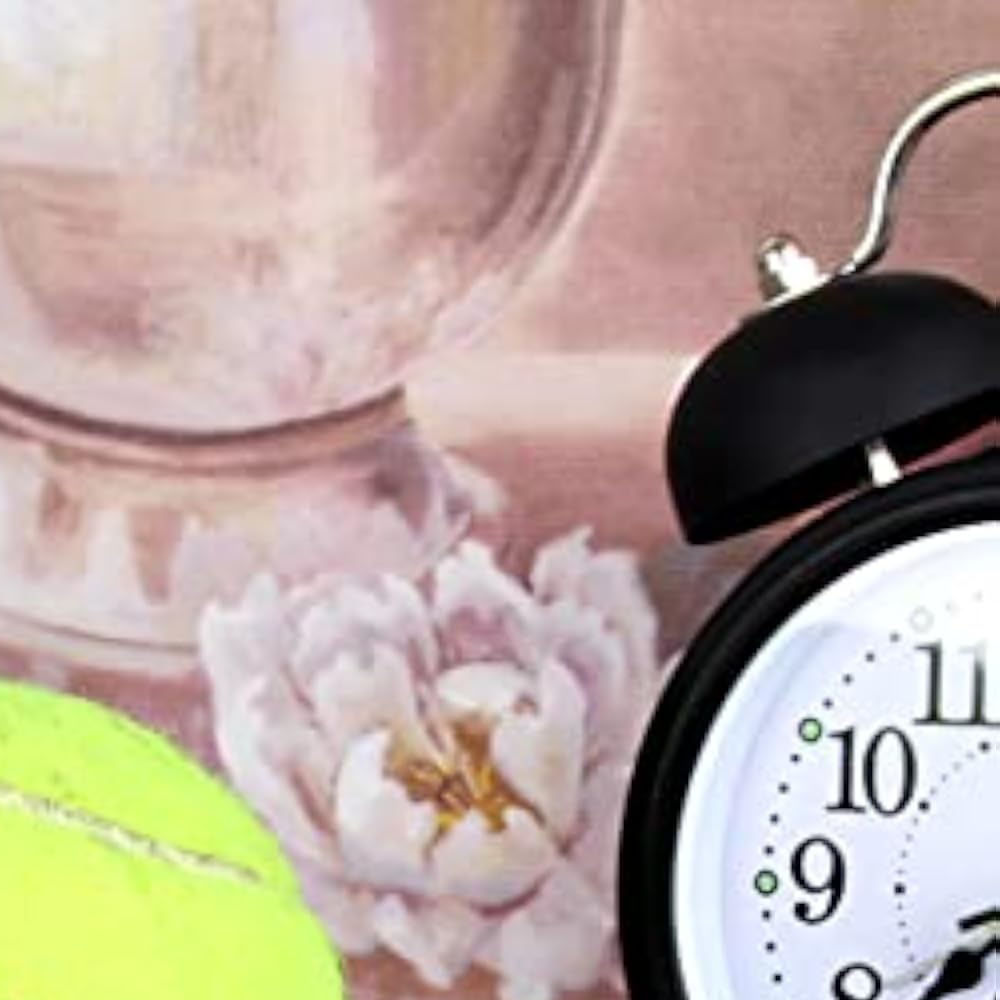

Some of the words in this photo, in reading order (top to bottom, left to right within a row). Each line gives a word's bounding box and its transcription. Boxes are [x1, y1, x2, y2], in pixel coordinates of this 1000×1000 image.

[912, 638, 1000, 727] 11
[825, 726, 917, 815] 10
[789, 837, 846, 924] 9
